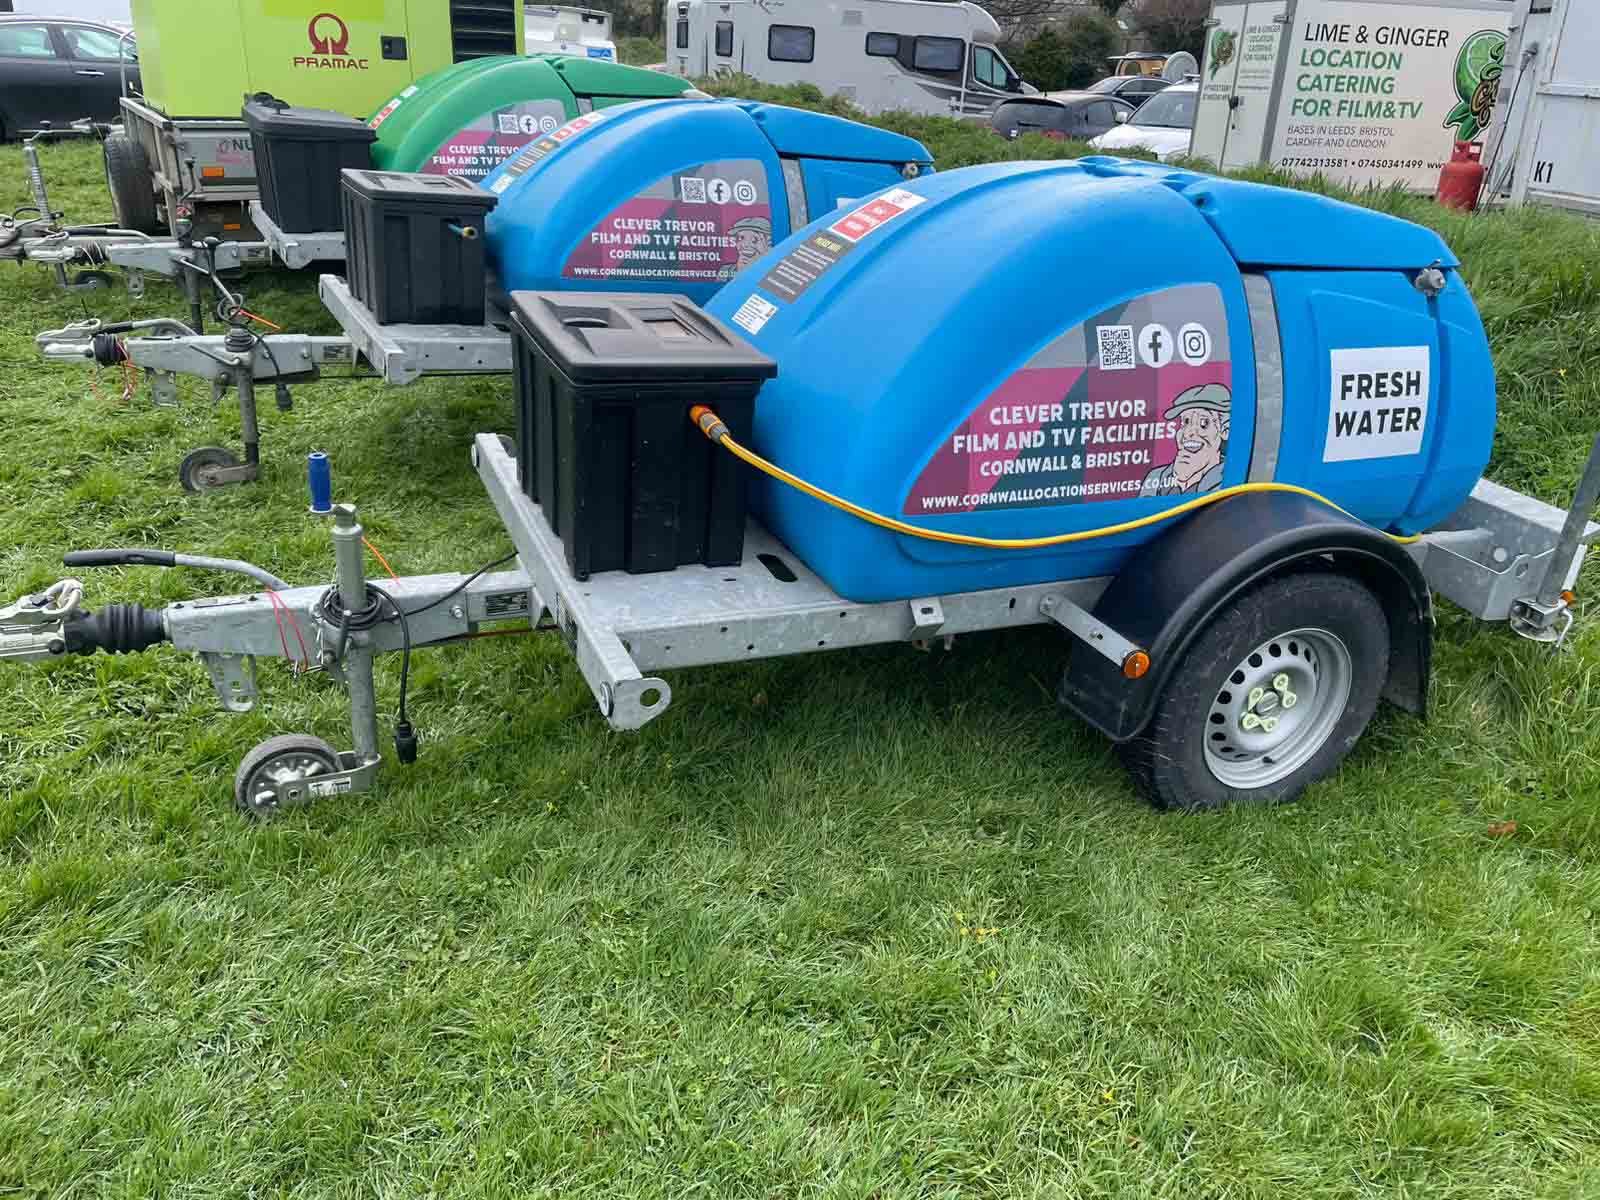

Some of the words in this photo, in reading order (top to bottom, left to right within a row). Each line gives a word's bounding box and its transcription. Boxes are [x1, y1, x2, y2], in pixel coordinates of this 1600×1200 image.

[1304, 23, 1351, 43] LIME
[1355, 25, 1369, 43] &
[1375, 26, 1449, 47] GINGER
[293, 57, 369, 69] PRAMAC
[1300, 48, 1403, 70] LOCATION
[1296, 74, 1395, 94] CATERING
[1291, 99, 1332, 117] FOR
[1337, 100, 1423, 119] FILM&TV
[1287, 125, 1315, 135] BASES
[1317, 126, 1327, 135] IN
[448, 145, 486, 155] CLEVER
[1285, 137, 1323, 147] CARDIFF
[1326, 138, 1345, 147] AND
[1346, 139, 1387, 149] LONDON
[432, 156, 456, 164] FILM
[457, 156, 479, 165] AND
[481, 157, 493, 165] TV
[1281, 157, 1349, 168] 07742313581
[1357, 159, 1424, 169] 07450341499
[1533, 160, 1553, 184] K1
[613, 218, 662, 231] CLEVER
[664, 220, 716, 233] TREVOR
[591, 232, 621, 245] FILM
[624, 233, 650, 245] AND
[654, 234, 670, 246] TV
[673, 234, 737, 248] FACILITIES
[609, 249, 667, 261] CORNWALL
[669, 250, 676, 260] &
[678, 251, 721, 262] BRISTOL
[1341, 370, 1421, 401] FRESH
[989, 404, 1064, 426] CLEVER
[1069, 400, 1147, 422] TREVOR
[1335, 406, 1422, 438] WATER
[953, 433, 999, 454] FILM
[1004, 430, 1046, 450] AND
[1051, 428, 1076, 447] TV
[1081, 421, 1177, 445] FACILITIES
[980, 456, 1067, 477] CORNWALL
[1071, 454, 1082, 469] &
[1086, 450, 1151, 468] BRISTOL
